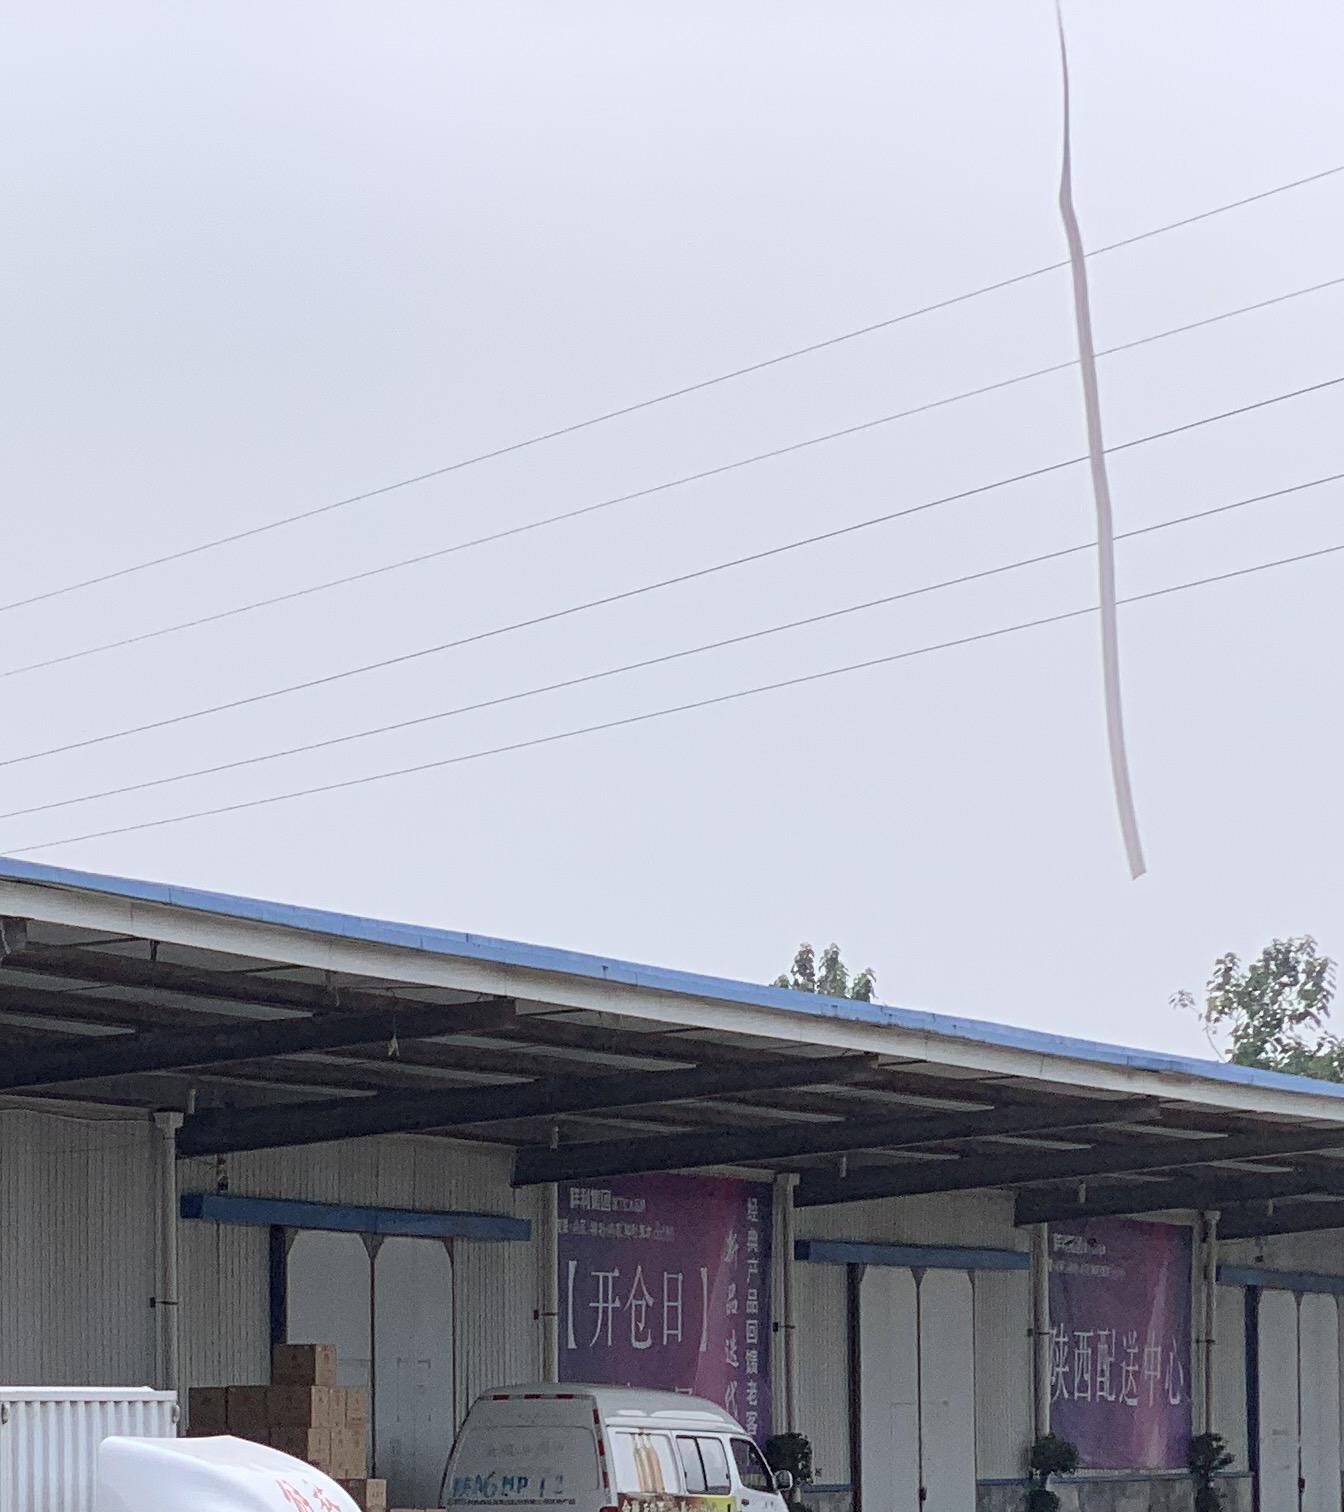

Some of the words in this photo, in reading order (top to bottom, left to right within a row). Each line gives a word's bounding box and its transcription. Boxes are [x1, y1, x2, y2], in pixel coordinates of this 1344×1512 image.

[1049, 1323, 1185, 1408] 陕西配送中心
